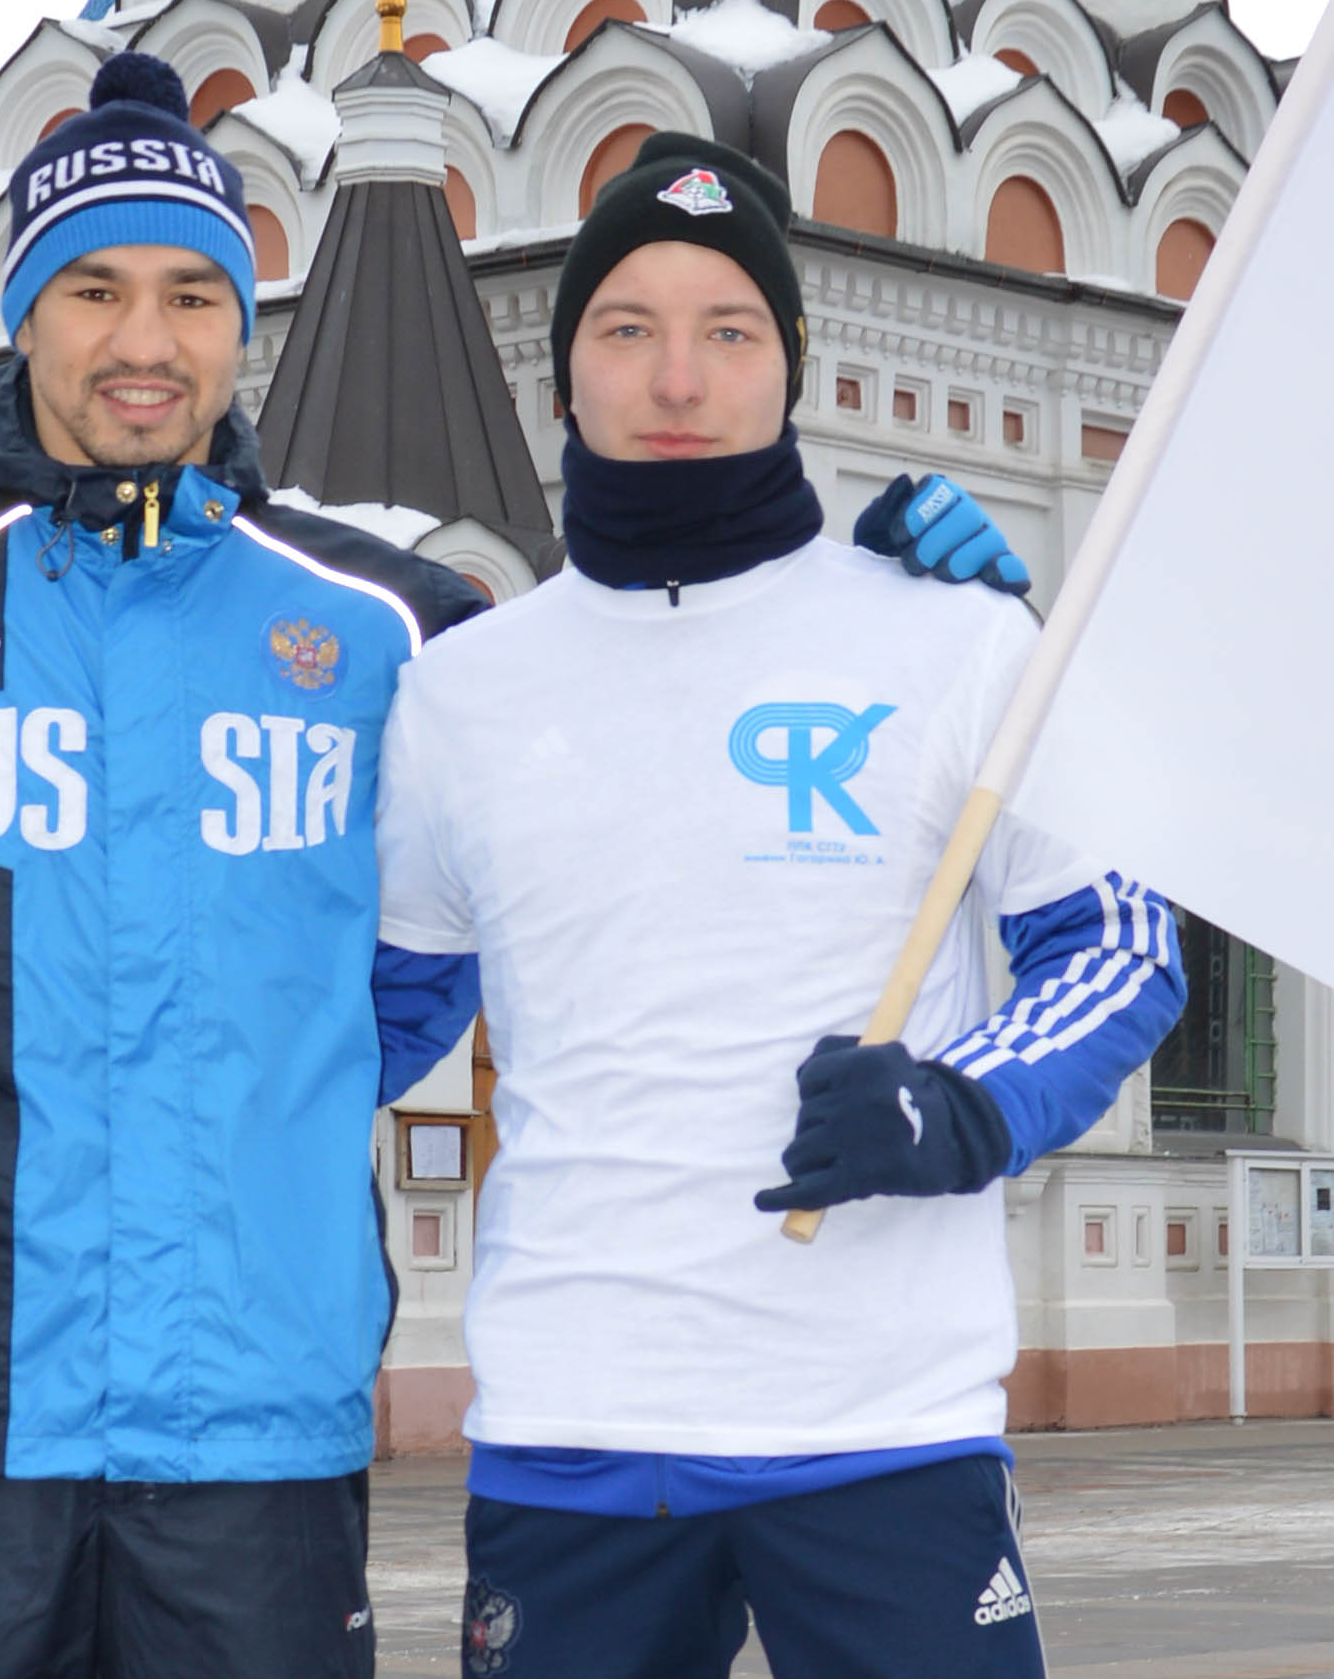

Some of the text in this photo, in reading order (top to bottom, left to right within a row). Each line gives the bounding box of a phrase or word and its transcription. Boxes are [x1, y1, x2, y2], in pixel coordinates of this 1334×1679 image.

[28, 139, 225, 211] RUSSIA
[200, 711, 357, 856] SIA
[974, 1593, 1032, 1626] adidas
